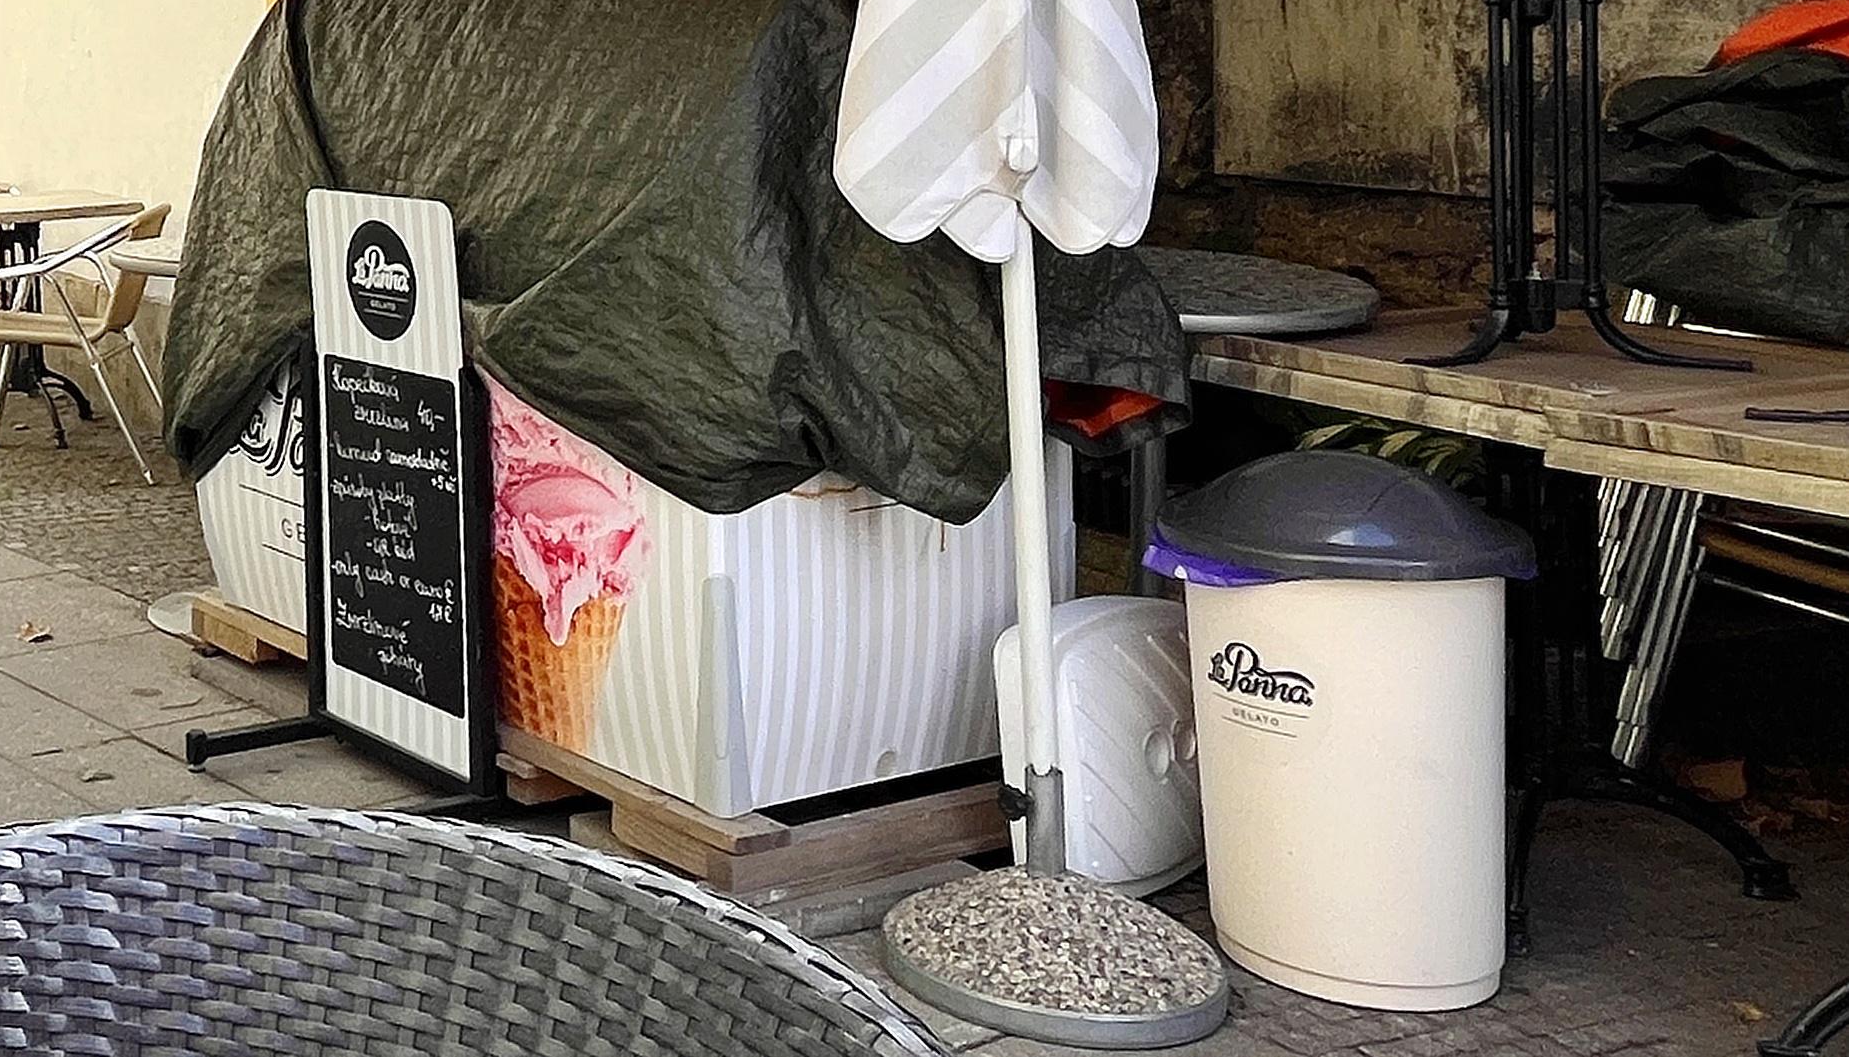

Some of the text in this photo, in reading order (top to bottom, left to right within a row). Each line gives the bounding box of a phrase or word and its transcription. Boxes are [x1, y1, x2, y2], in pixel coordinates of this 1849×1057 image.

[363, 245, 411, 293] Panna
[1224, 642, 1316, 707] Panna
[1232, 708, 1281, 727] GELATO
